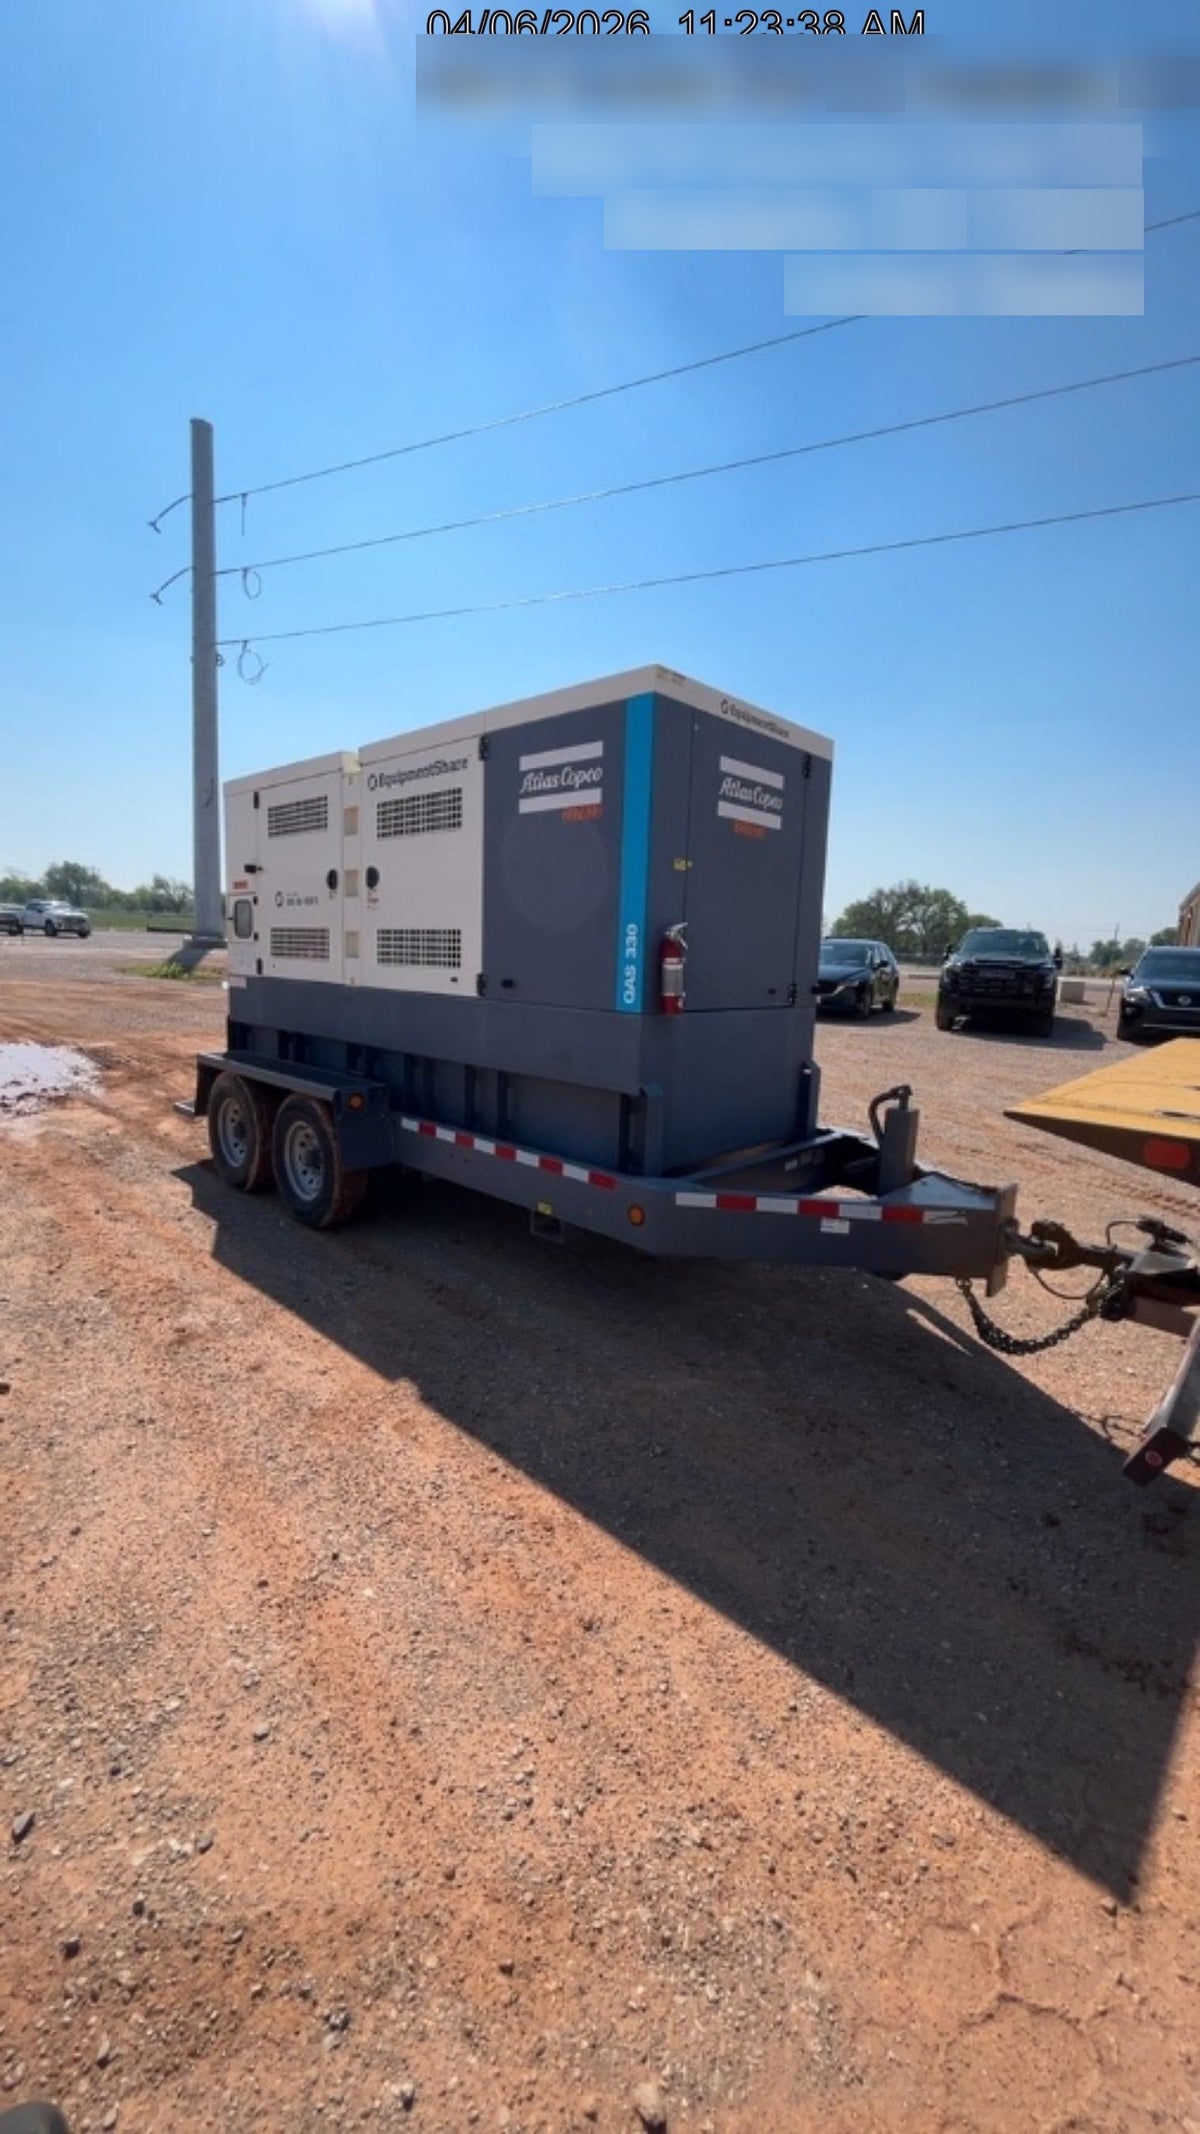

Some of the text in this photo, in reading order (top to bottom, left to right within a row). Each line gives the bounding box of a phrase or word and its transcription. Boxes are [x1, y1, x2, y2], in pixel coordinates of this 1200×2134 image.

[379, 758, 468, 789] EquipmentShare
[520, 765, 603, 794] Atlas Copco
[719, 777, 783, 810] Atlas Copco
[623, 923, 638, 1004] QAS 330
